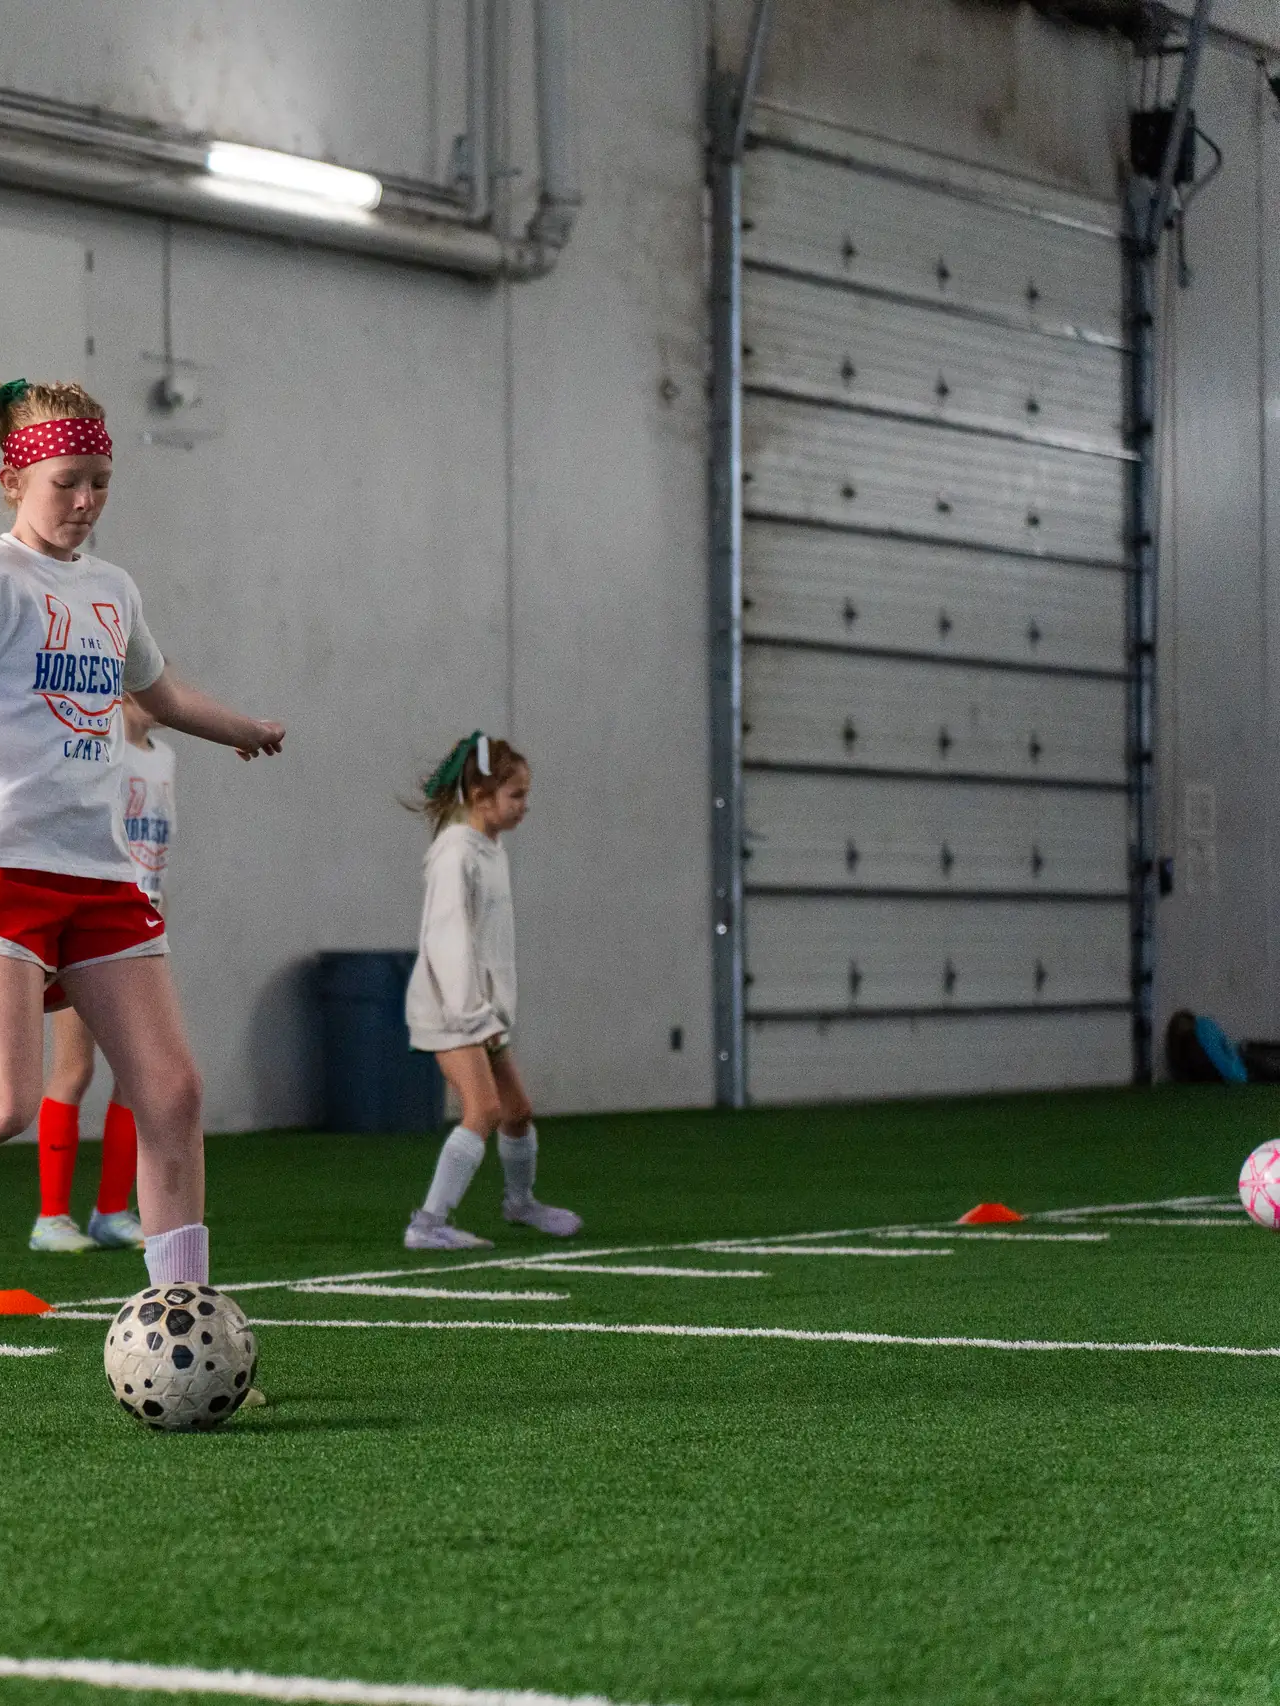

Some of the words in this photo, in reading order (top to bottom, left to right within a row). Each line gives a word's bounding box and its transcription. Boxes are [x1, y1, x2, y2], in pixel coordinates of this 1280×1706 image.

[80, 637, 103, 650] THE
[32, 652, 125, 697] HORSESH
[59, 700, 109, 727] COLLECT
